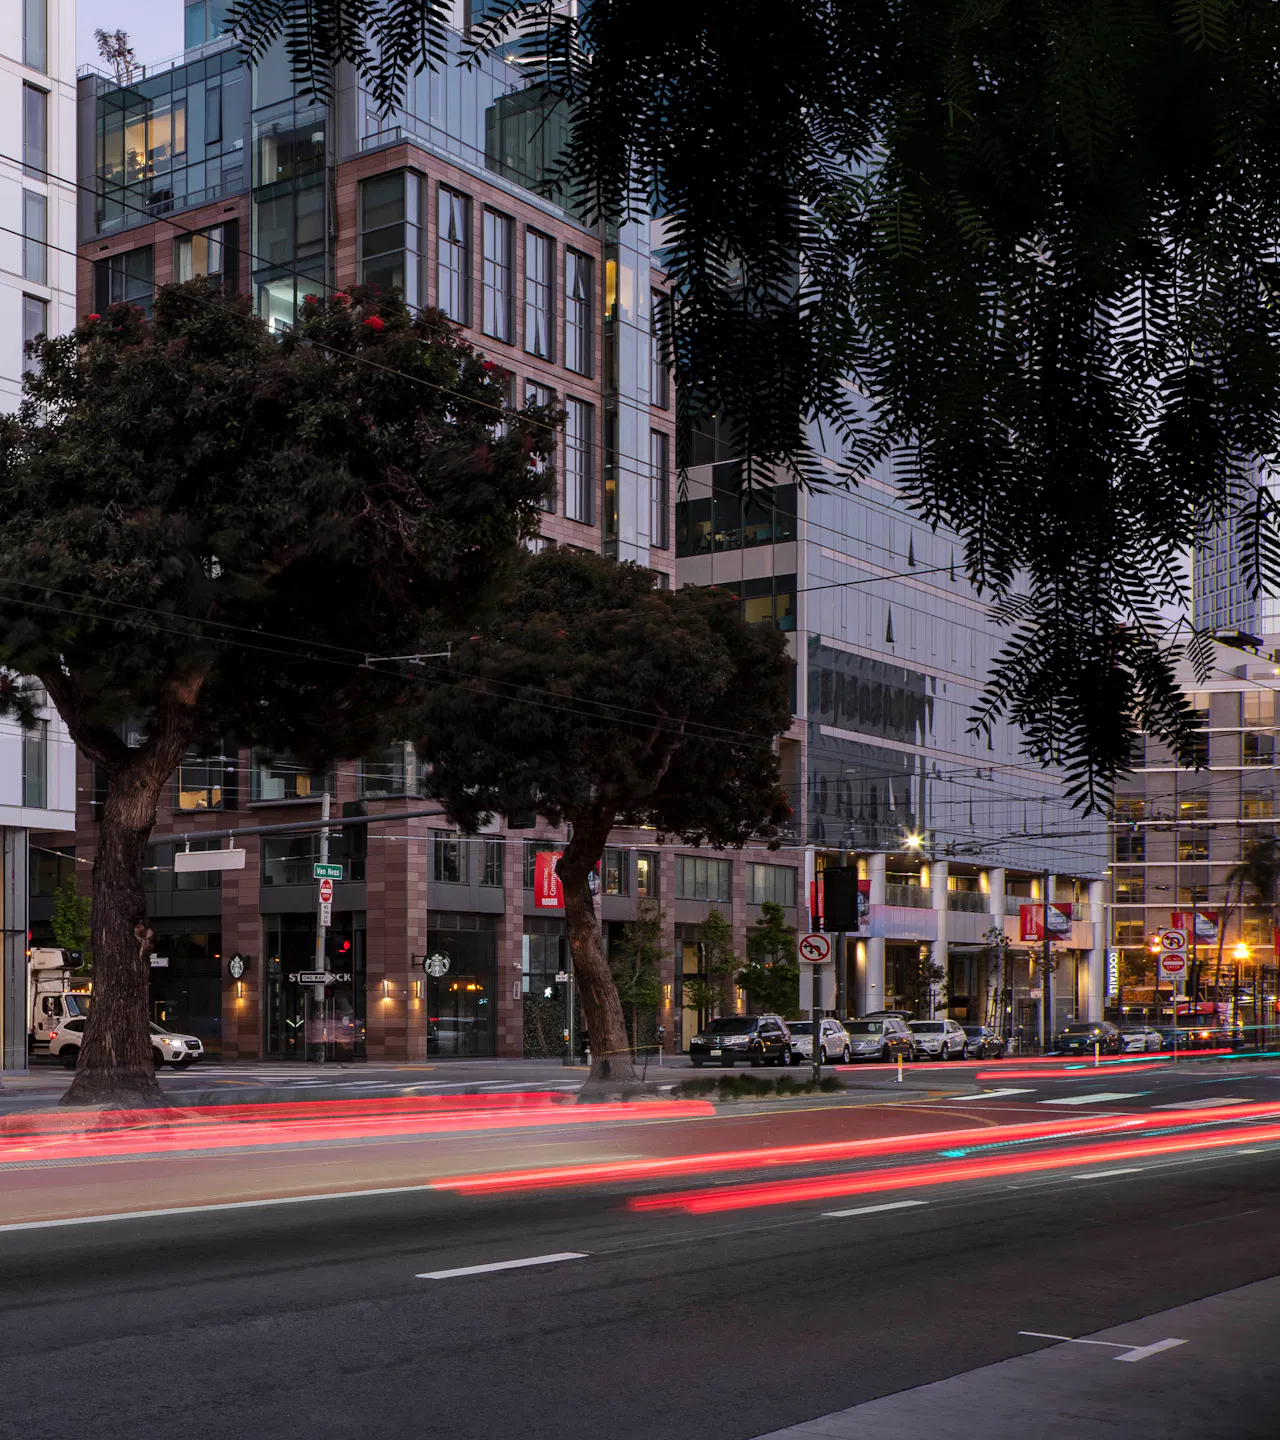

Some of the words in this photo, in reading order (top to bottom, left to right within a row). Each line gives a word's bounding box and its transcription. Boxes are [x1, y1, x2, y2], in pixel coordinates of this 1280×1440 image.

[316, 867, 326, 875] Van
[328, 868, 340, 876] Ness
[1109, 952, 1118, 994] COCKTAILS
